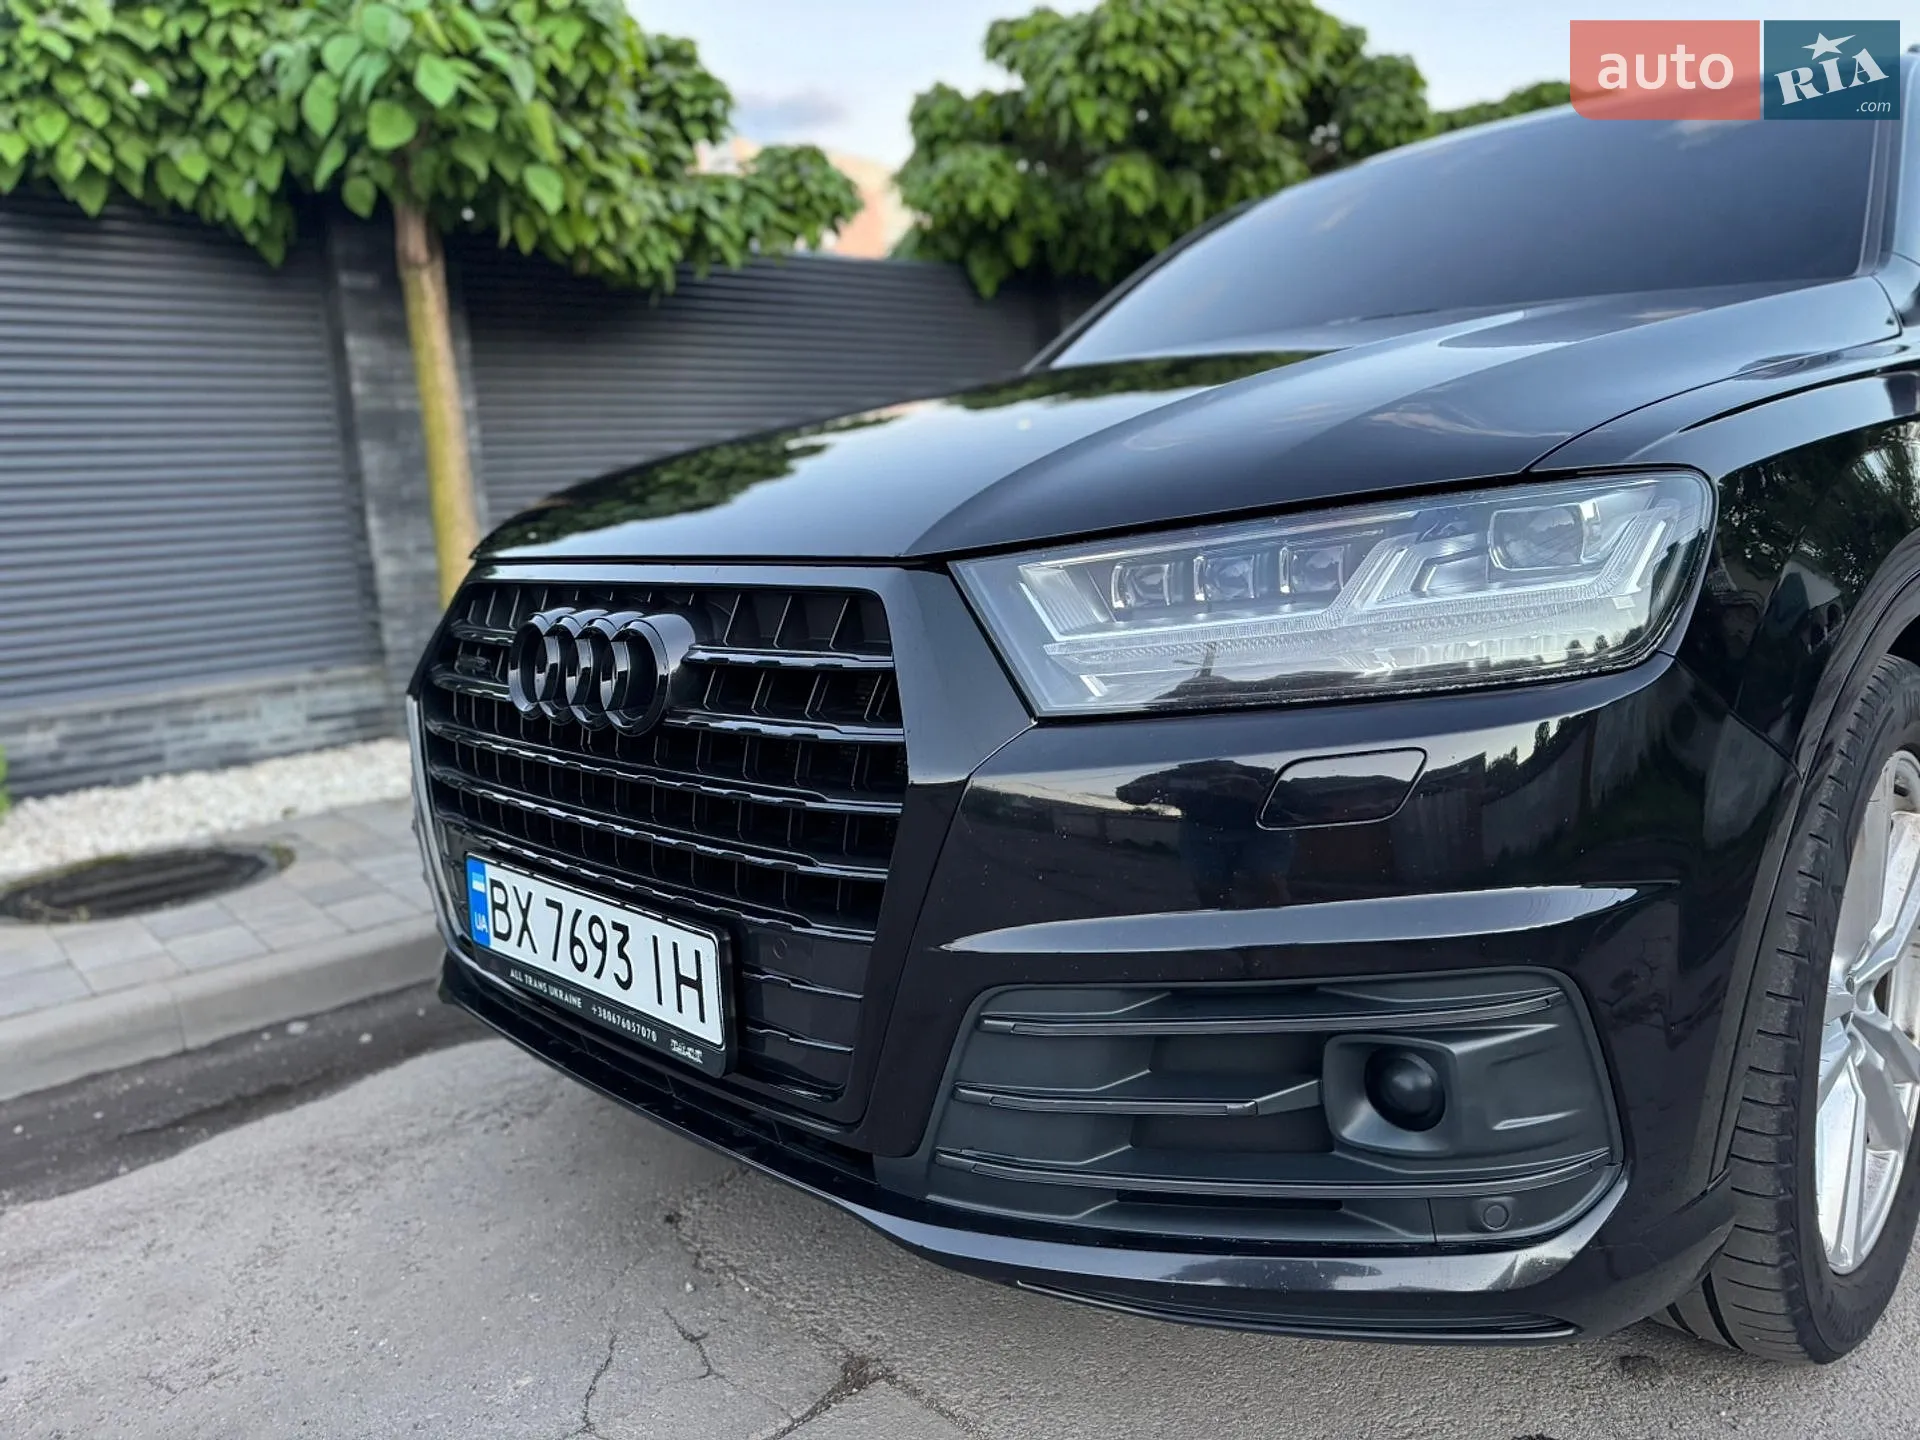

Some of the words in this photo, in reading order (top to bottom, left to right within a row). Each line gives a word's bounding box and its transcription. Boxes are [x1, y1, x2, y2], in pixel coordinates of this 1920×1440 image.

[474, 912, 488, 934] UA
[489, 877, 538, 955] BX
[545, 897, 634, 991] 7693
[651, 934, 707, 1024] IH
[510, 967, 524, 983] ALL
[524, 973, 548, 993] TRANS
[547, 984, 583, 1009] UKRAINE
